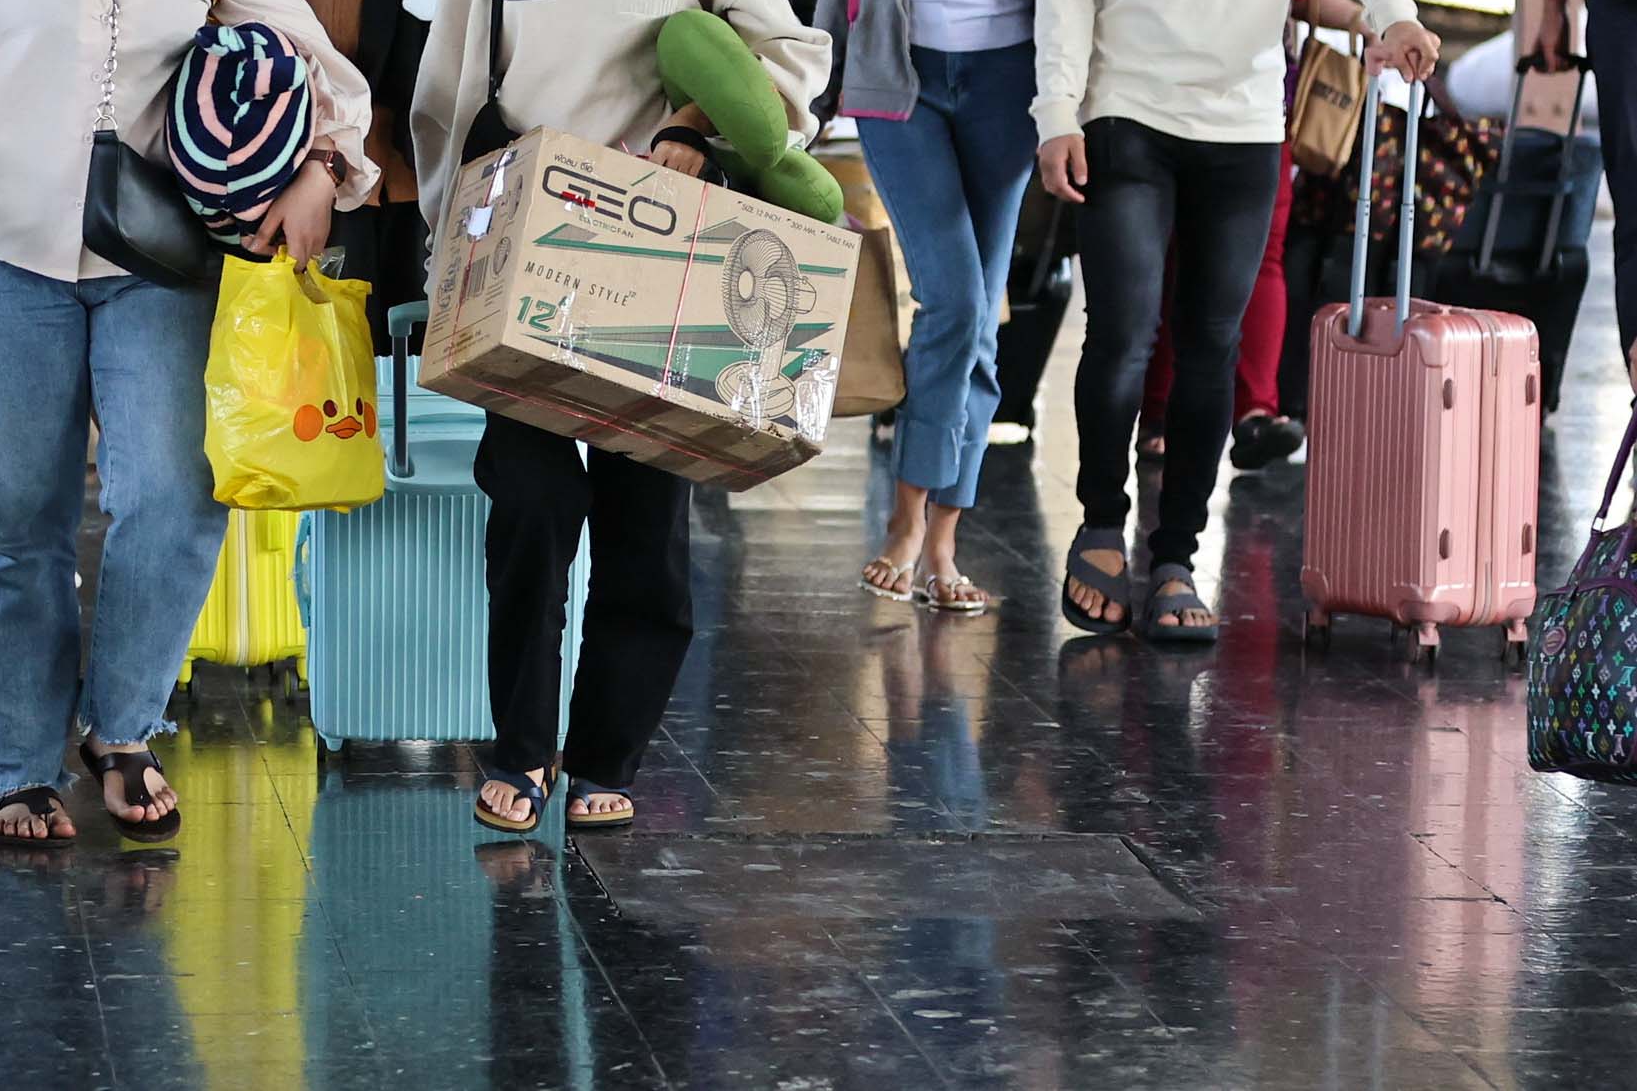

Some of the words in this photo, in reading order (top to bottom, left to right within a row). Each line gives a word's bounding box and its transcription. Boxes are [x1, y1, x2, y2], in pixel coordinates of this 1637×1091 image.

[542, 165, 677, 236] GEO
[524, 261, 581, 290] MODERN
[588, 283, 629, 307] STYLE
